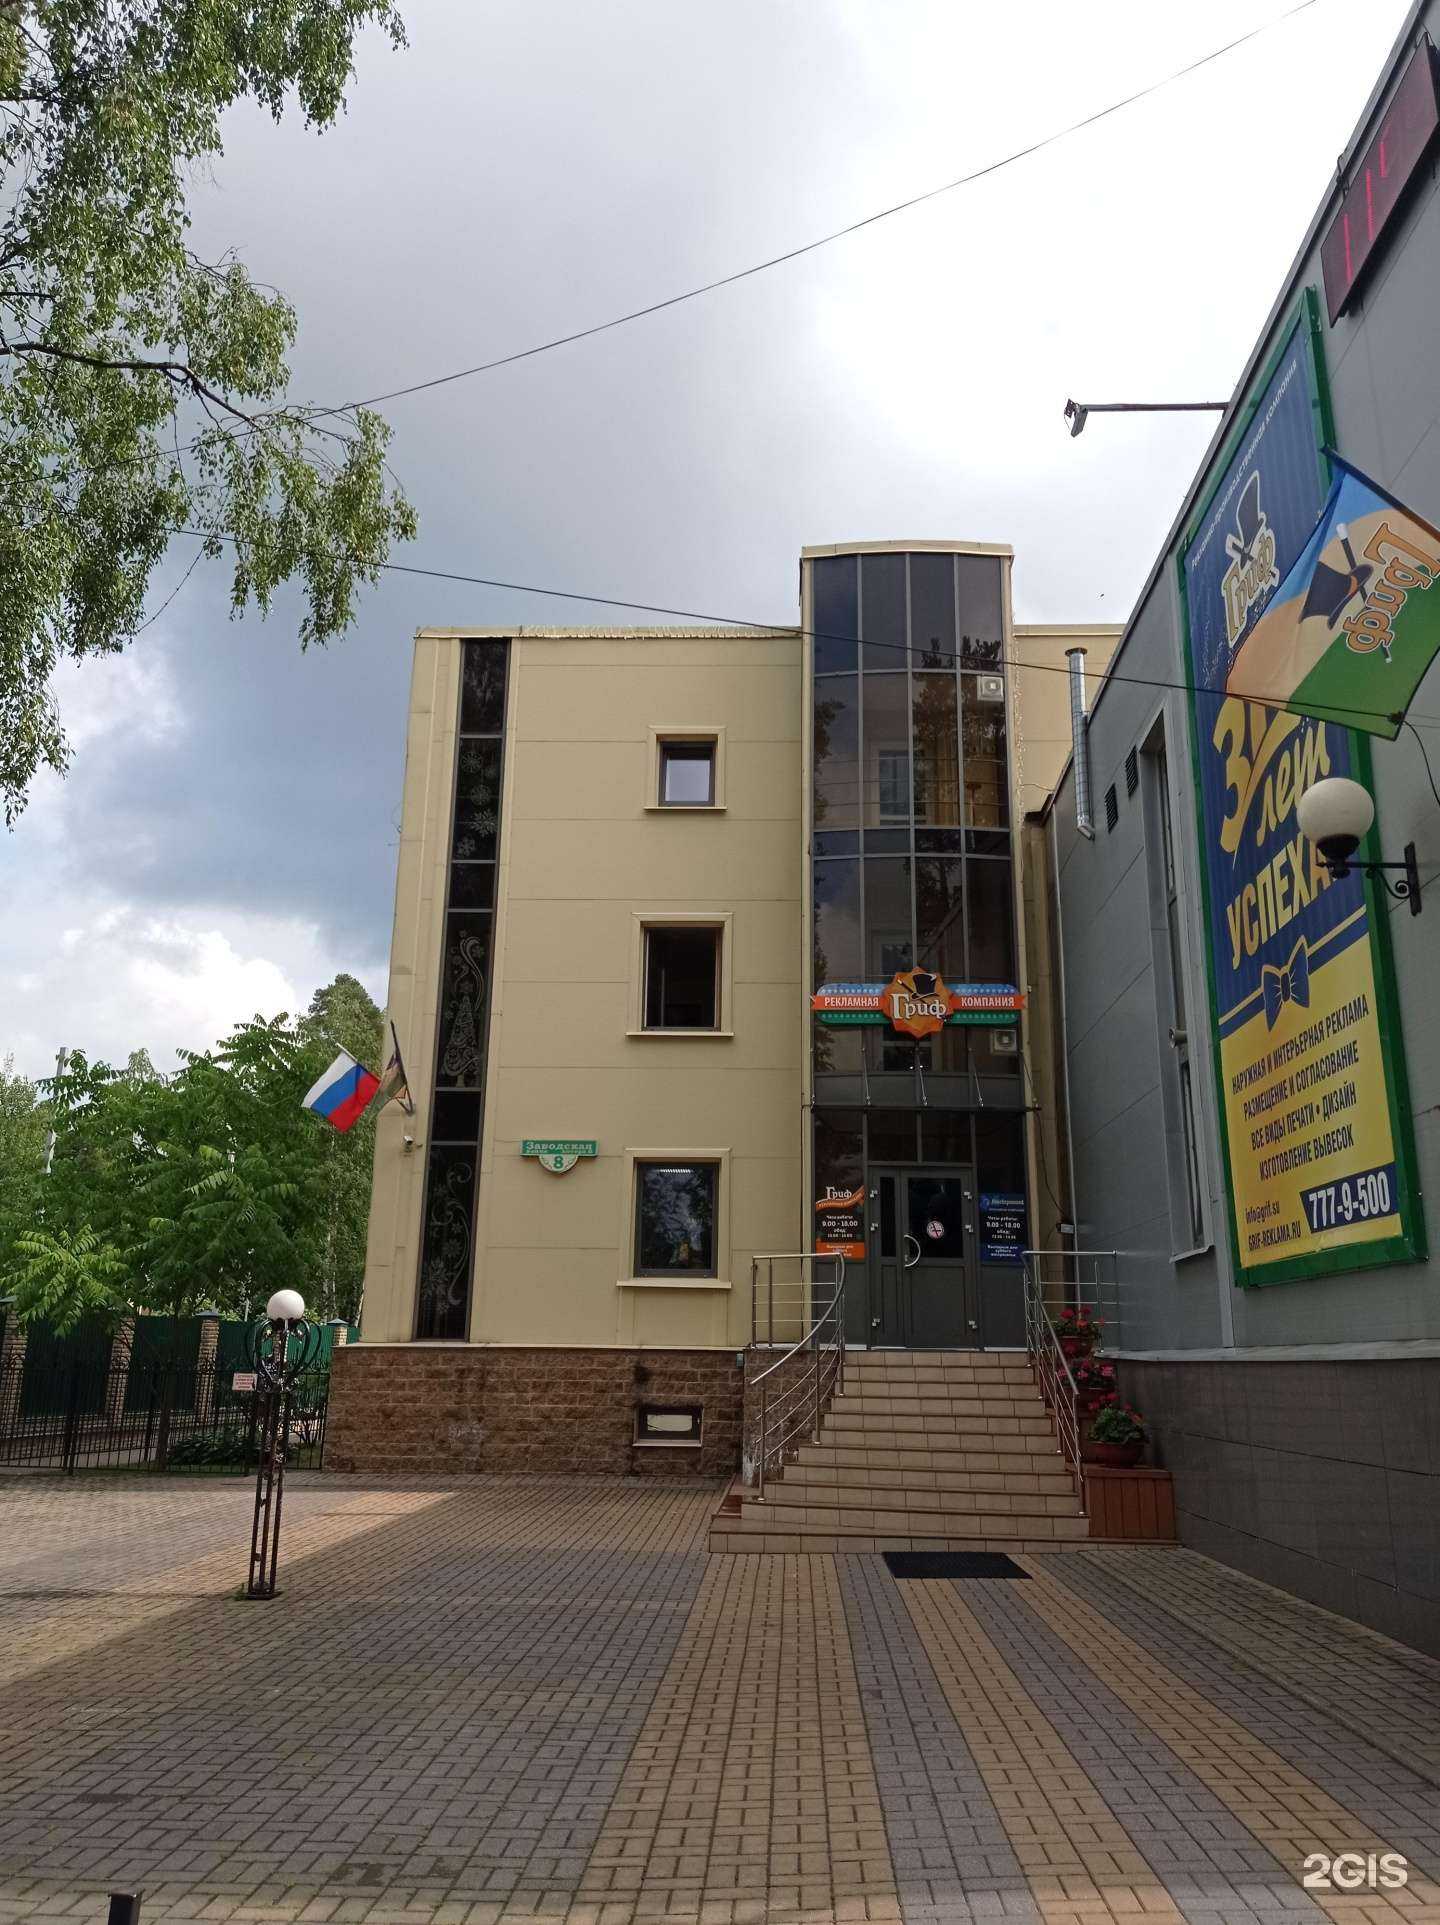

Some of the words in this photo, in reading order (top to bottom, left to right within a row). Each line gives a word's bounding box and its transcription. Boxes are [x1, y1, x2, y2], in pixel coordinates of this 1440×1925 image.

[1342, 521, 1440, 653] Гриф
[824, 997, 879, 1007] РЕКЛАМНАЯ
[890, 992, 946, 1020] Гриф
[961, 996, 1014, 1007] КОМПАНИЯ
[1232, 1057, 1266, 1095] НАРУЖНАЯ
[1272, 1019, 1325, 1071] ИНТЕРЬЕРНАЯ
[1325, 994, 1369, 1038] РЕКЛАМА
[1243, 1079, 1289, 1121] РАЗМЕЩЕНИЕ
[1295, 1040, 1359, 1092] СОГЛАСОВАНИЕ
[1251, 1127, 1265, 1151] ВСЕ
[1265, 1119, 1286, 1143] ВИДЫ
[1287, 1102, 1315, 1133] ПЕЧАТИ
[1322, 1080, 1357, 1122] ДИЗАЙН
[526, 1142, 593, 1150] Заводская
[1259, 1141, 1313, 1181] ИЗГОТОВЛЕНИЕ
[1313, 1123, 1354, 1160] ВЫВЕСОК
[553, 1155, 564, 1169] 8
[825, 1186, 852, 1200] Гриф
[1309, 1171, 1391, 1229] 777-9-500
[1245, 1200, 1280, 1225] info@grif.su
[1249, 1220, 1302, 1251] GRIF-REKLAMA.RU
